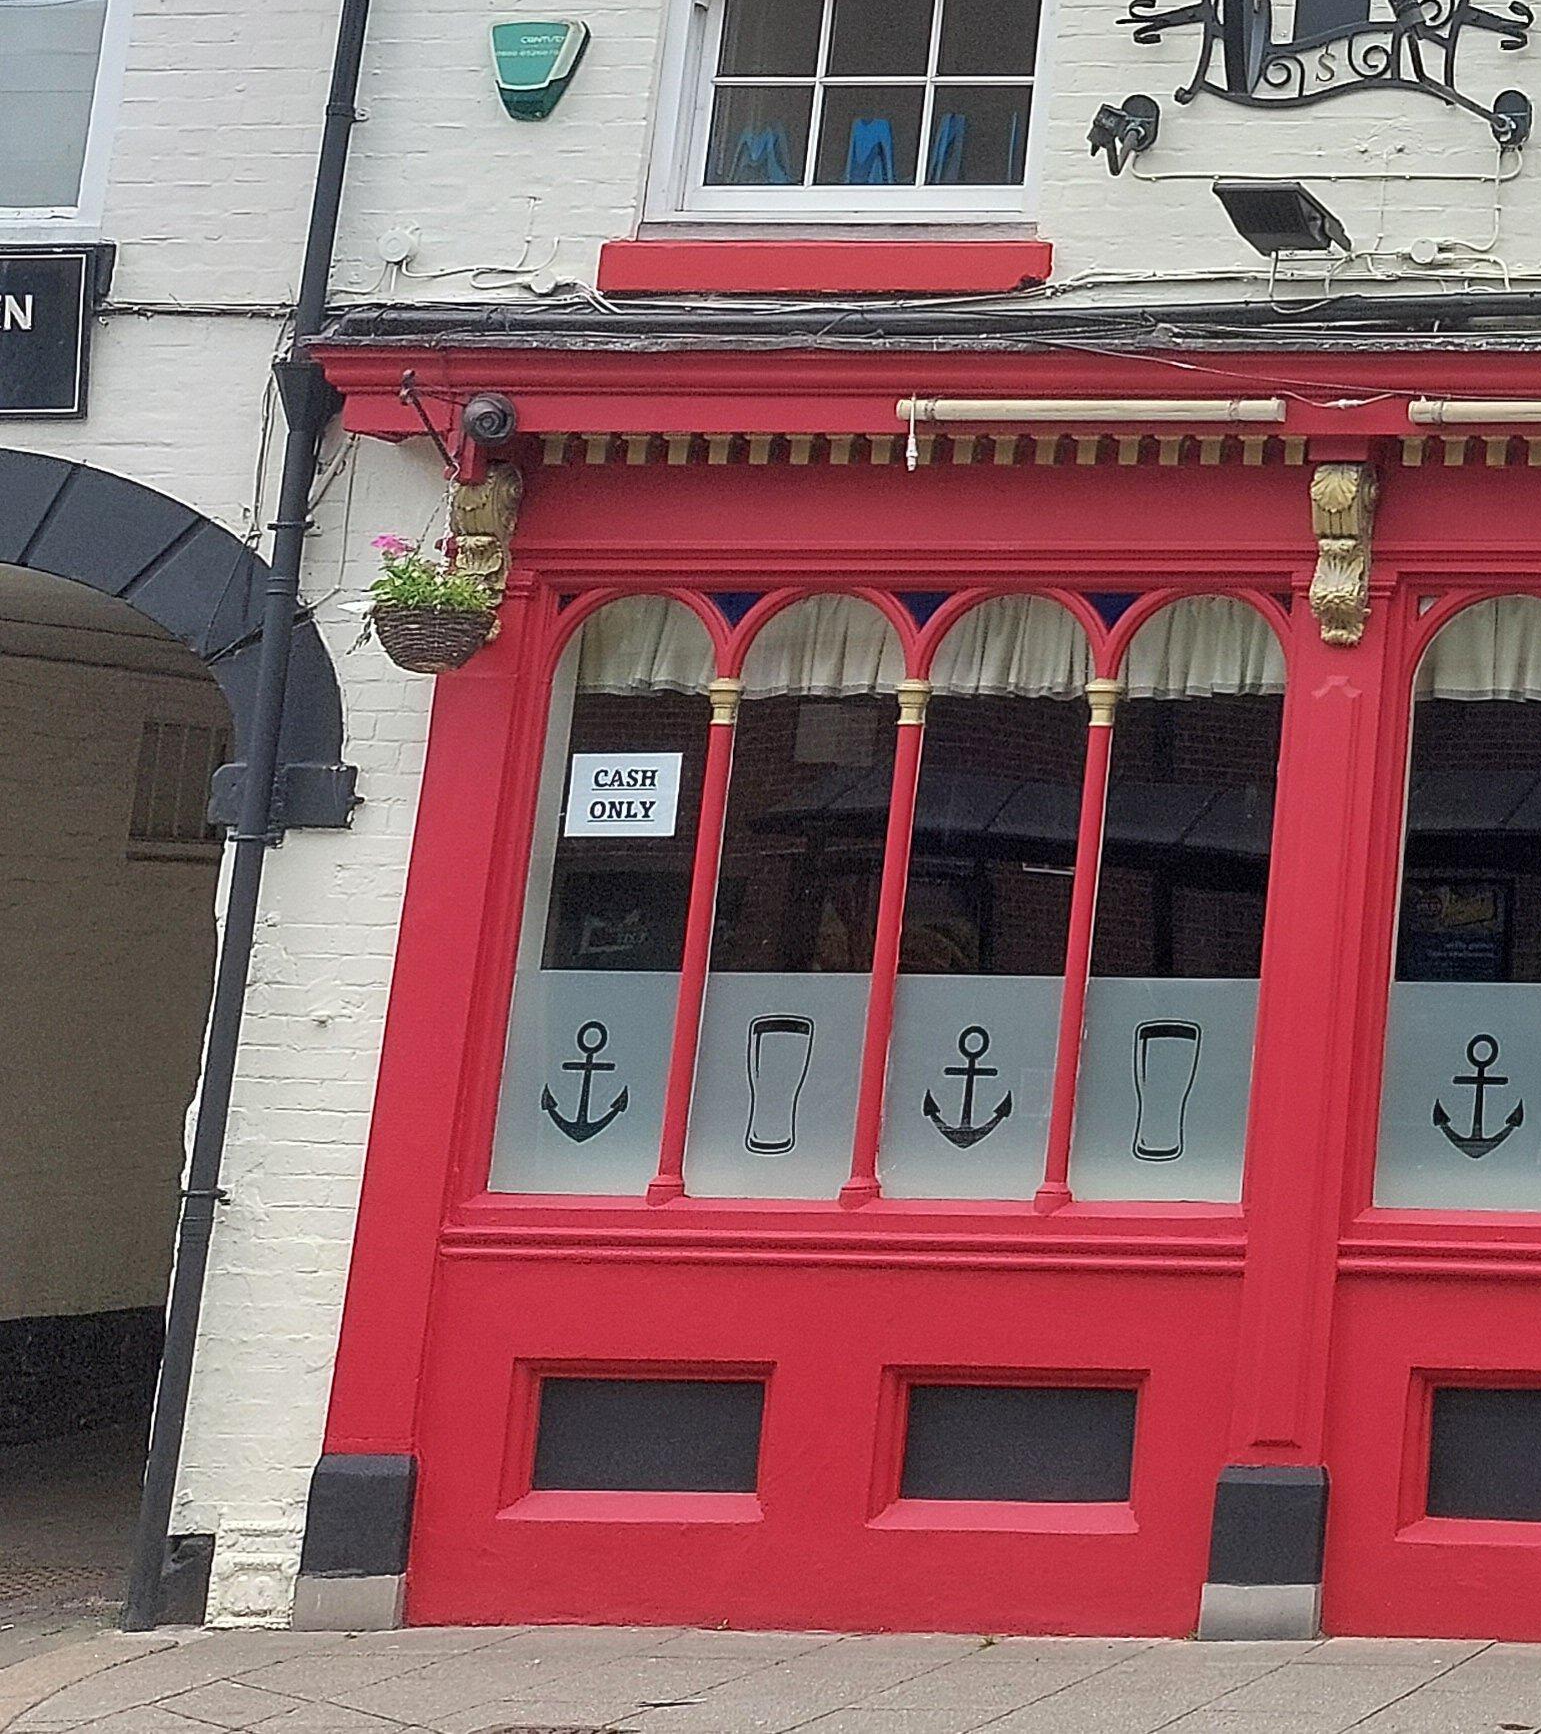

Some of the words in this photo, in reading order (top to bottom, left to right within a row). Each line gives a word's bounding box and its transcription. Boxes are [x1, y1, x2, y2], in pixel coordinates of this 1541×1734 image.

[1314, 51, 1337, 83] S
[0, 294, 33, 331] N
[593, 768, 659, 788] CASH
[589, 800, 657, 819] ONLY
